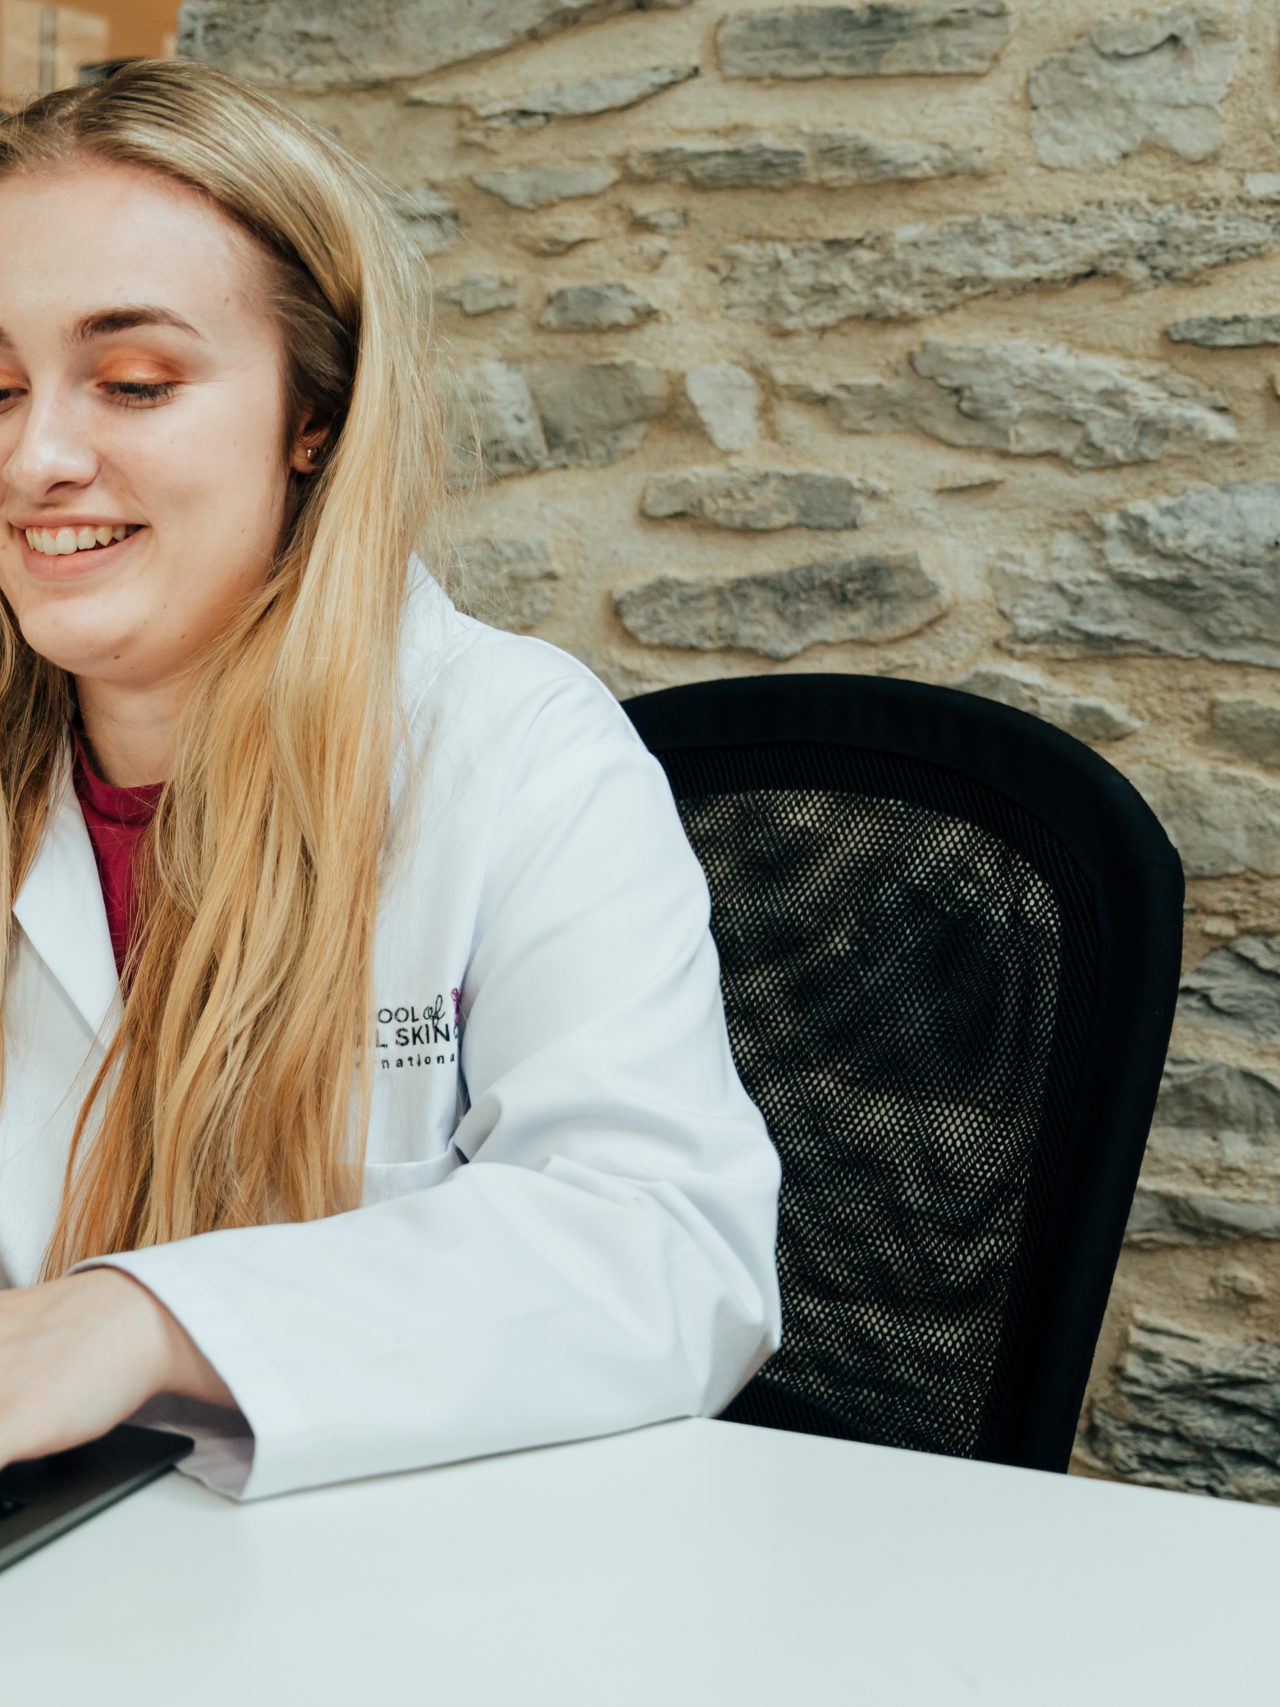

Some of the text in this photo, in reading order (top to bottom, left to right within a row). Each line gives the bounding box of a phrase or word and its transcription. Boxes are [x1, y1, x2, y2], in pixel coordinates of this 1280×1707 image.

[378, 994, 445, 1027] OOL of
[375, 1029, 388, 1048] L
[381, 1053, 455, 1070] nationa
